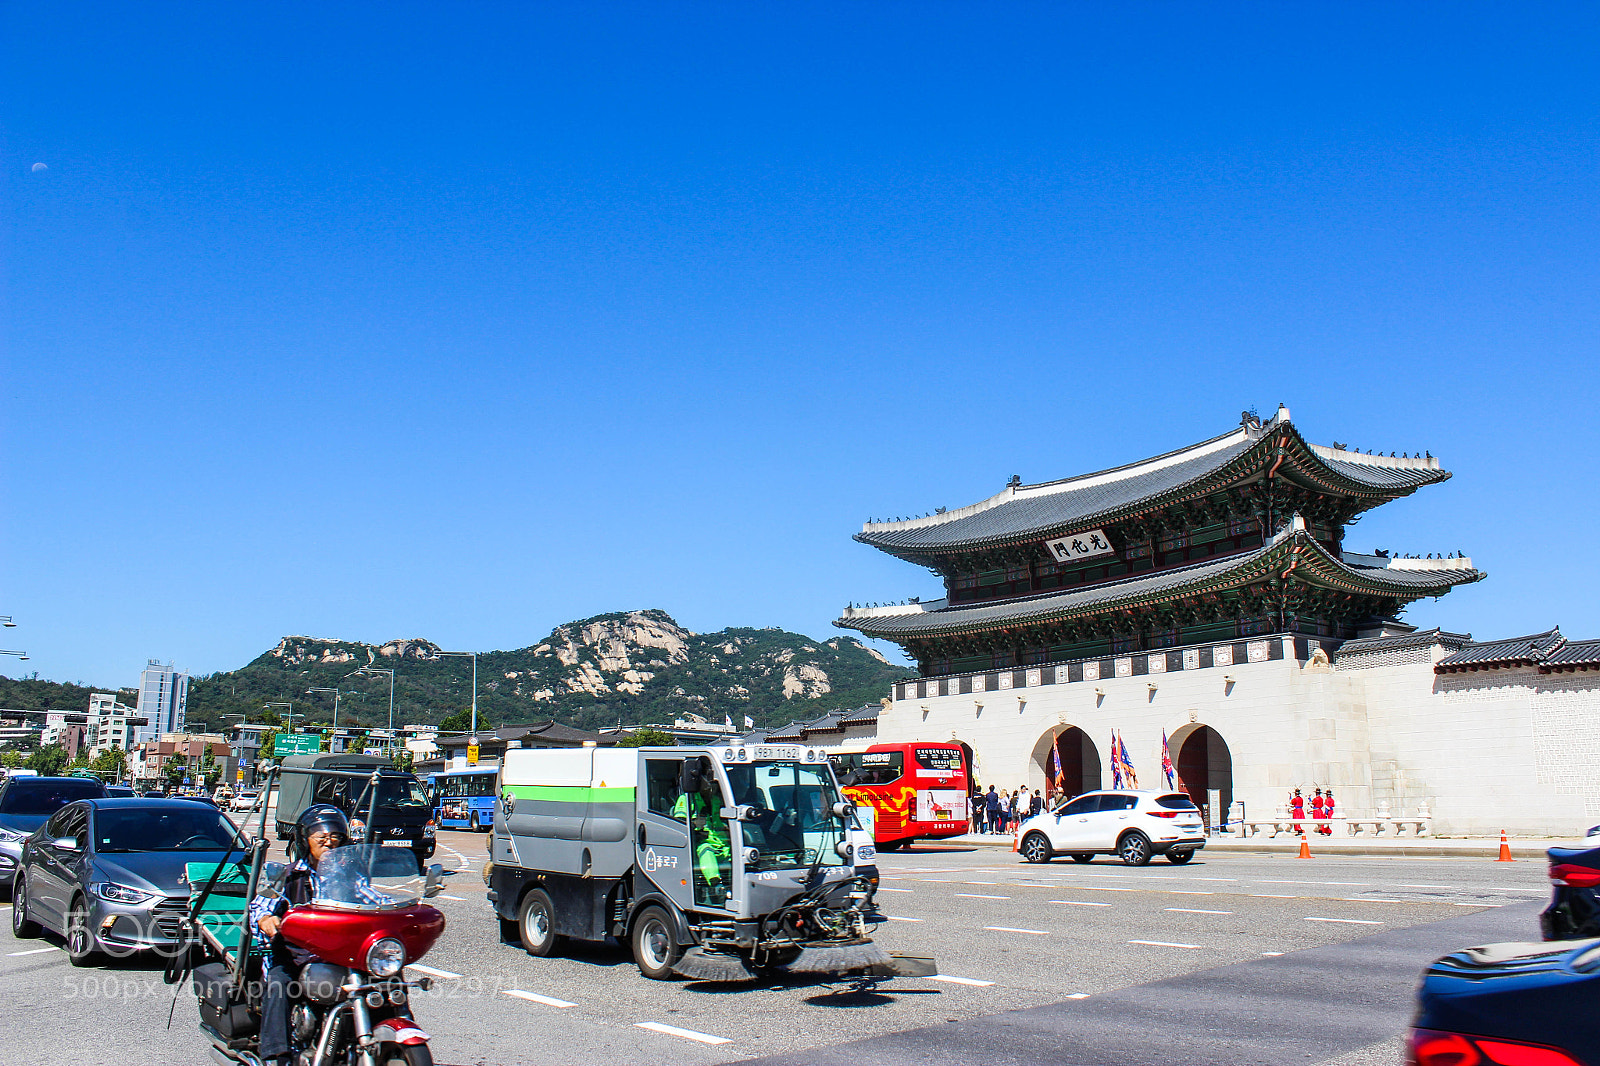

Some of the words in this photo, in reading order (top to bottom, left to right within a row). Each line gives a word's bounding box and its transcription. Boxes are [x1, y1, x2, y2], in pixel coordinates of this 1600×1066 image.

[777, 748, 796, 758] 1162
[856, 792, 893, 801] Limousine
[656, 855, 678, 869] 종로구
[756, 872, 778, 880] 709
